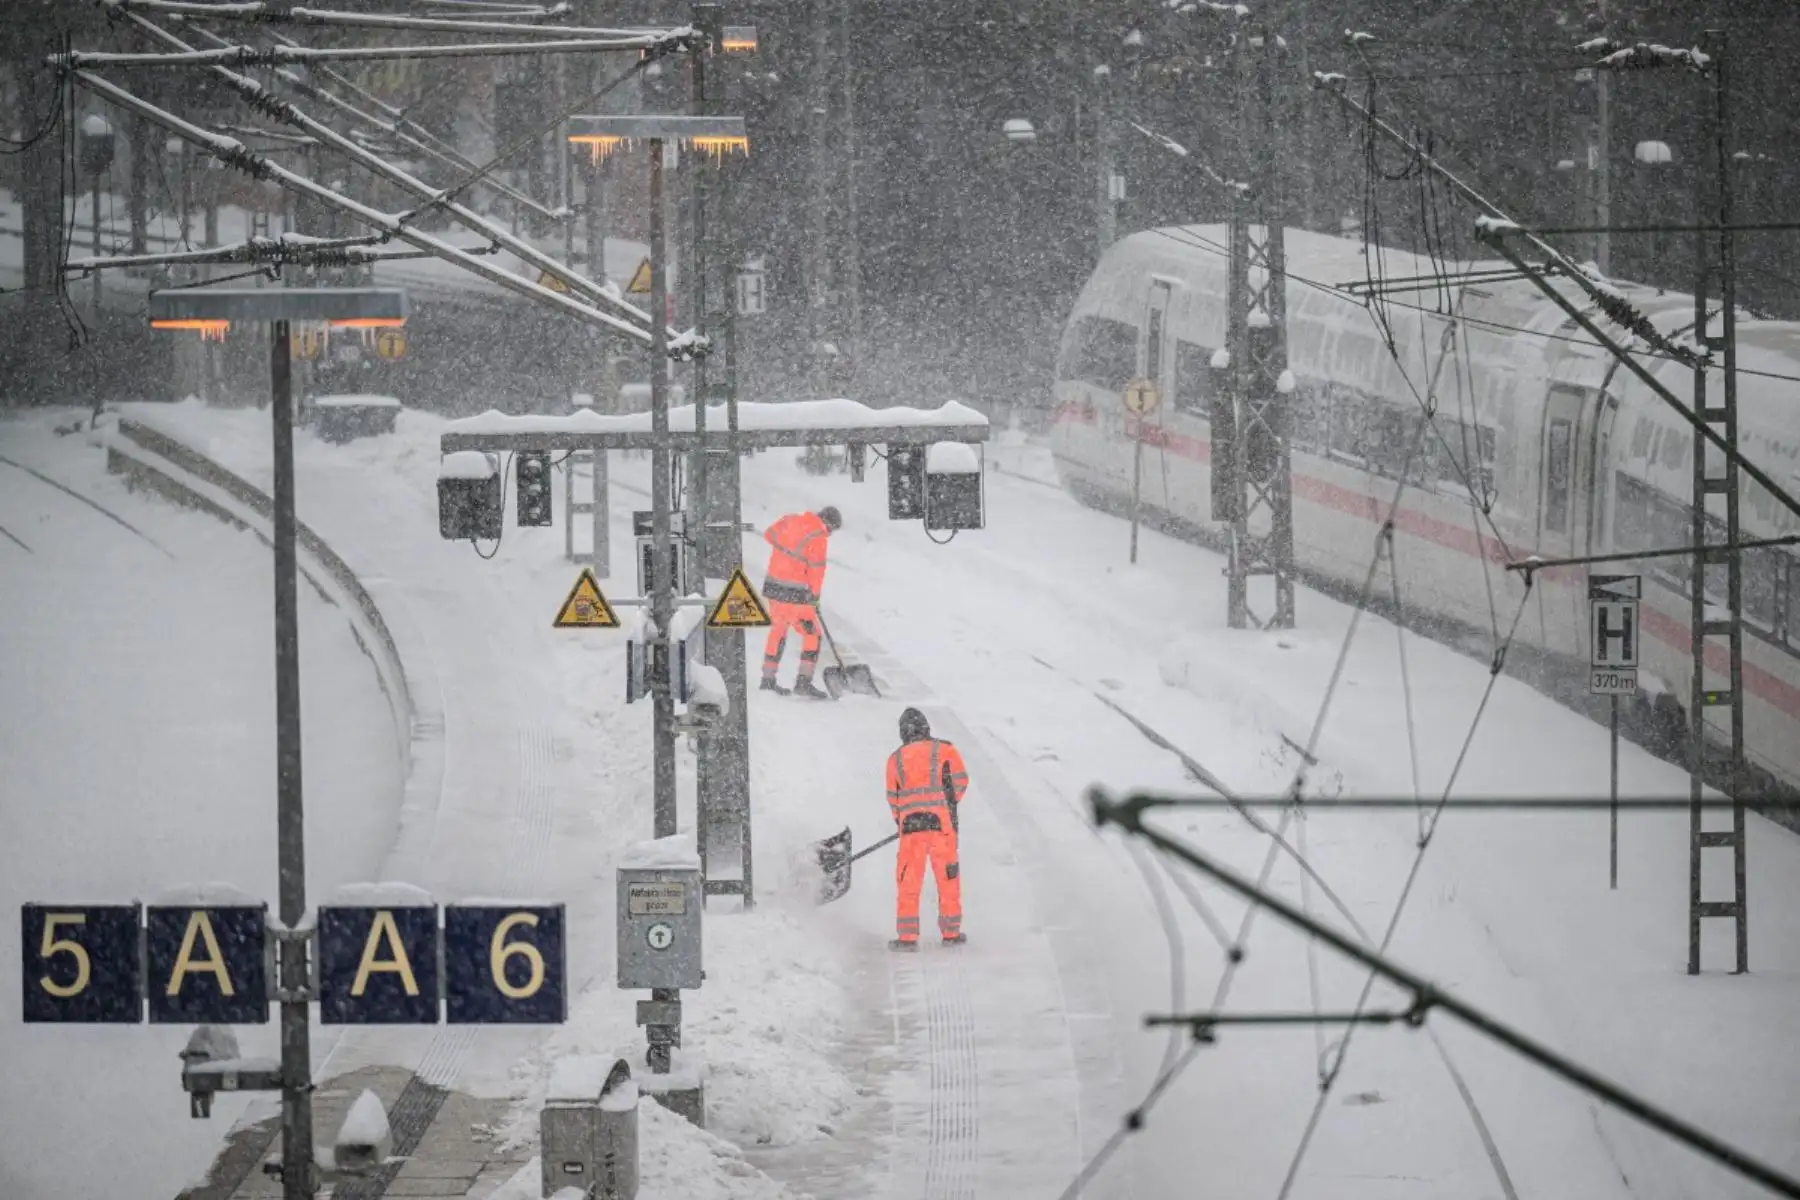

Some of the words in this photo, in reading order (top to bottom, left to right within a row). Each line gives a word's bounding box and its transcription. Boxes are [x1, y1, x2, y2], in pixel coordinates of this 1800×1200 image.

[1598, 607, 1632, 660] H
[39, 912, 90, 997] 5
[165, 911, 235, 995] A
[350, 911, 420, 995] A
[489, 912, 546, 998] 6
